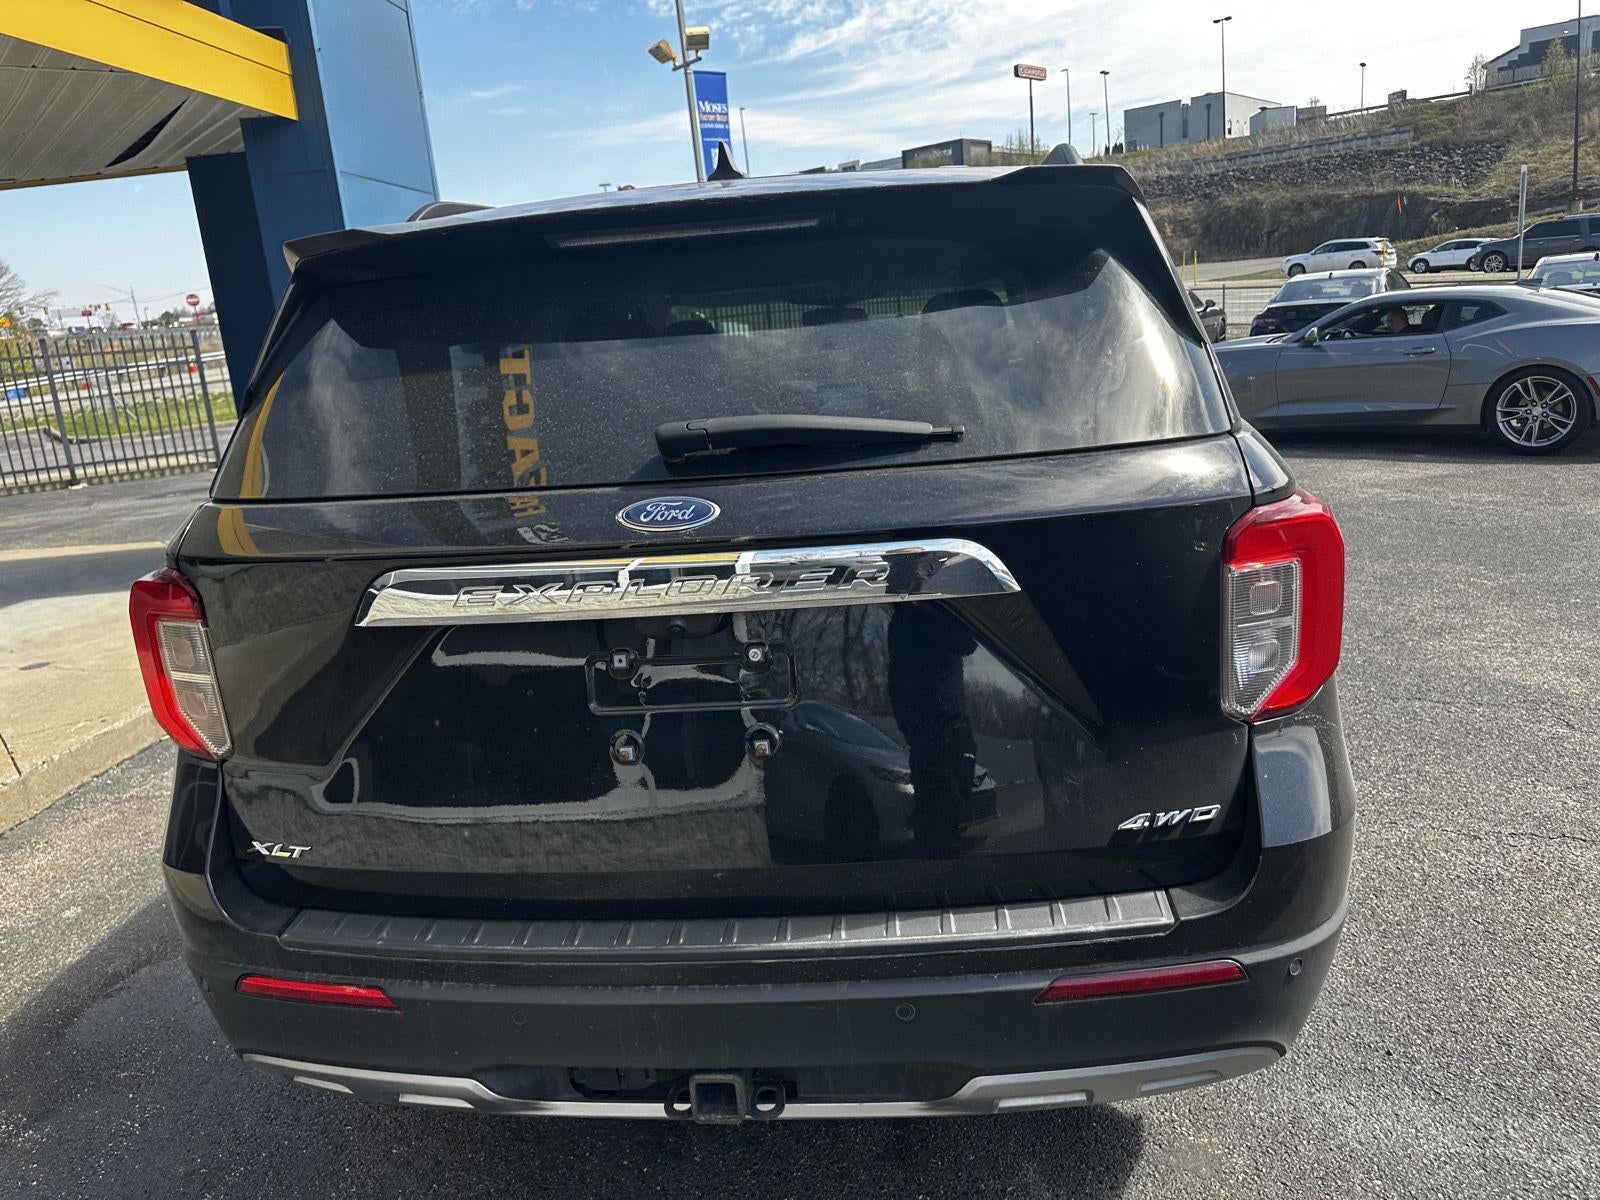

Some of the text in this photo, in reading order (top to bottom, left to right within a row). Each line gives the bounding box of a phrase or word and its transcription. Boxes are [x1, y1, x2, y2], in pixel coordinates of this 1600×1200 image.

[698, 101, 728, 113] MOSES
[640, 501, 696, 522] Ford
[452, 562, 891, 609] EXPLORER
[1118, 804, 1221, 831] 4WD
[247, 841, 312, 859] XLT
